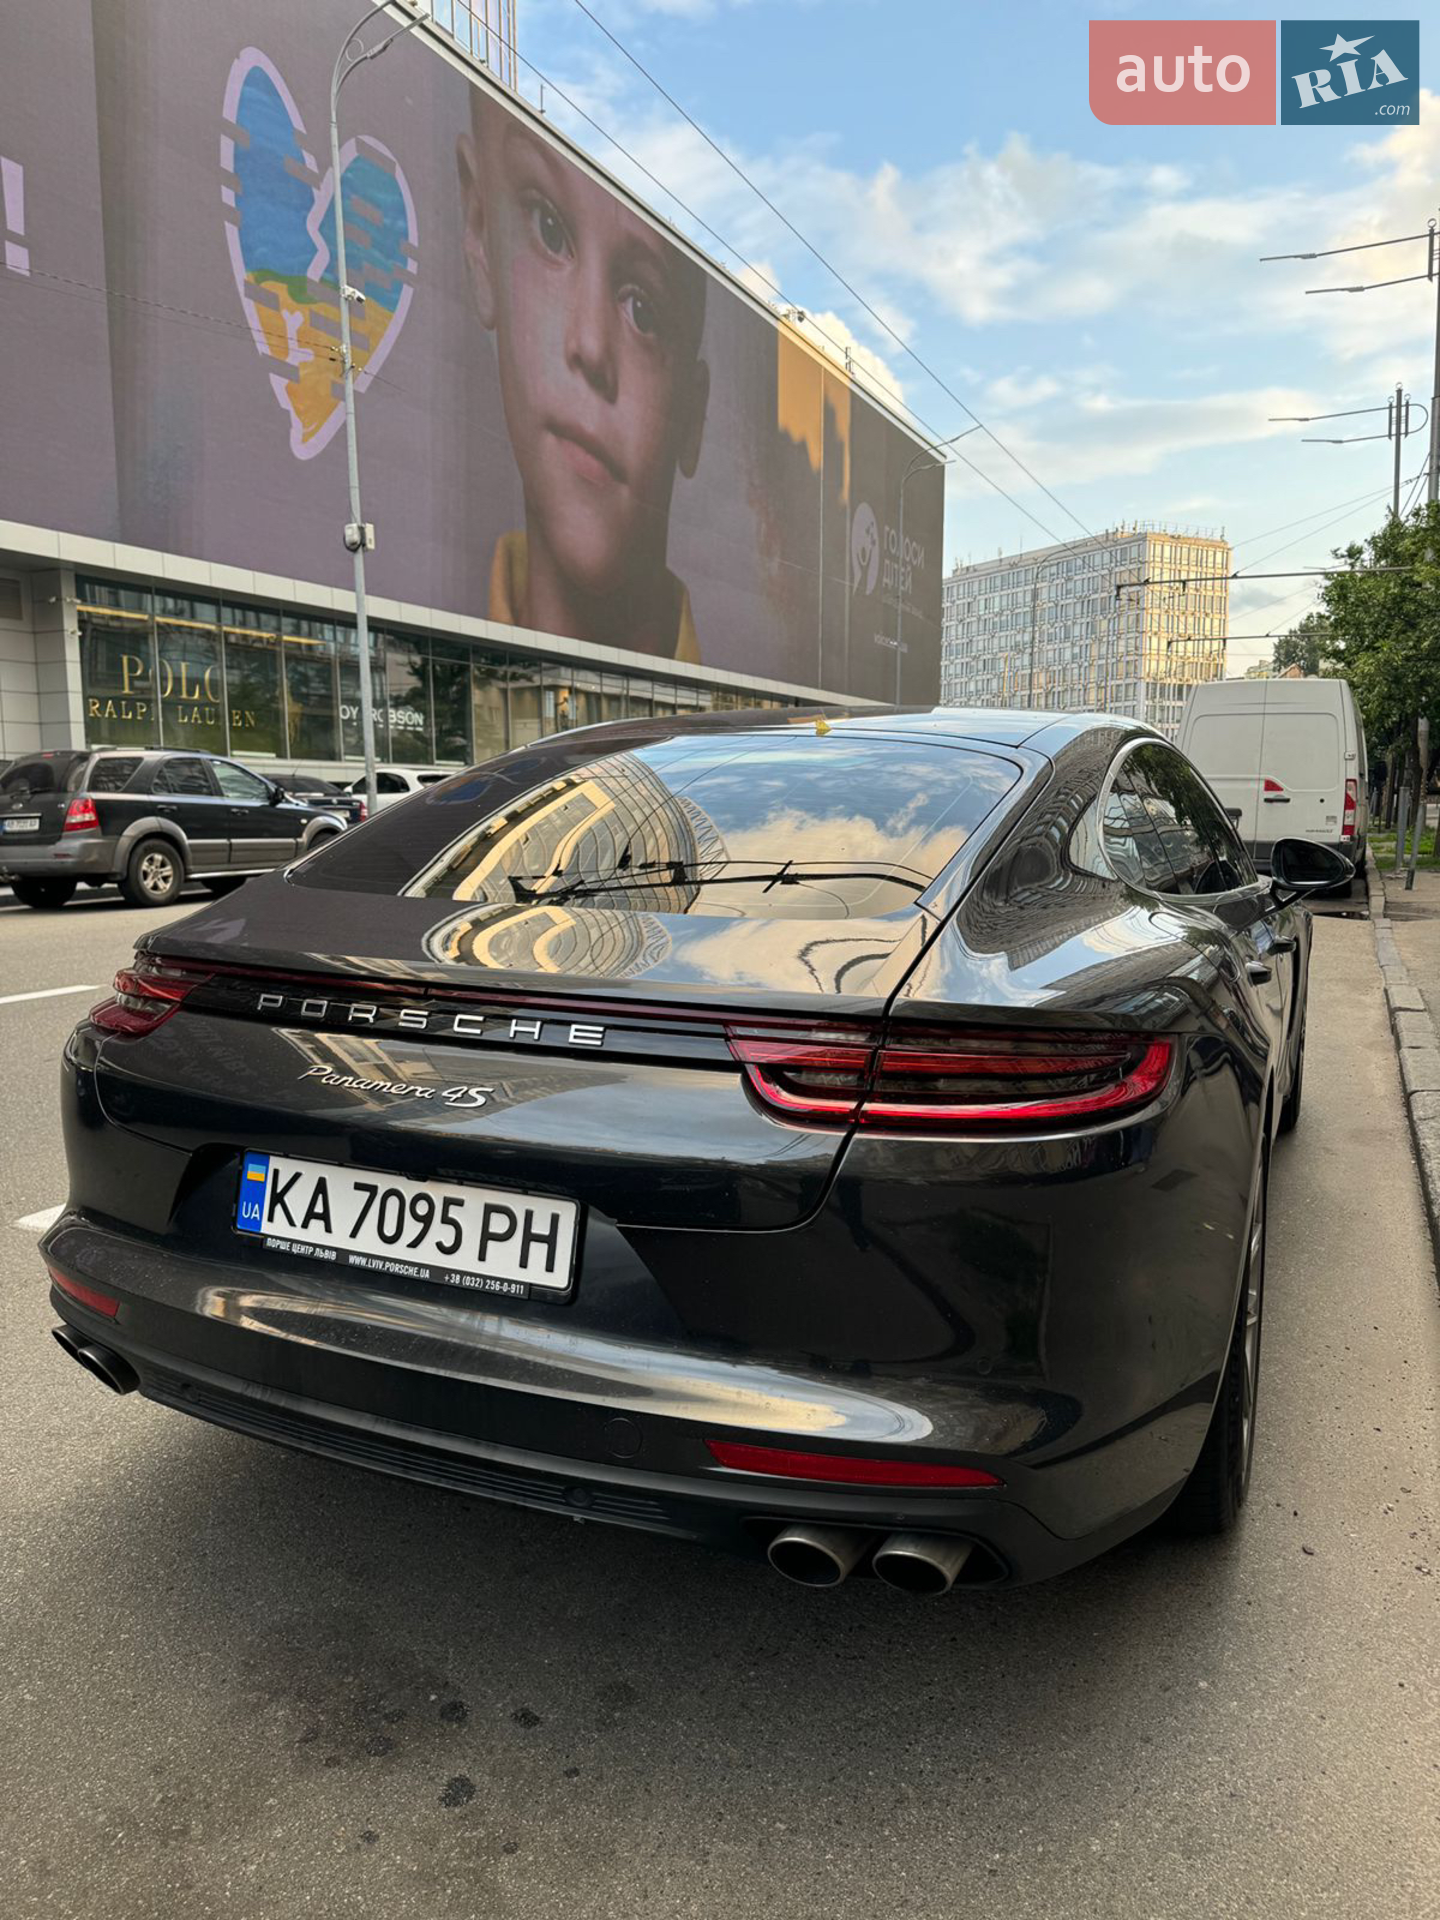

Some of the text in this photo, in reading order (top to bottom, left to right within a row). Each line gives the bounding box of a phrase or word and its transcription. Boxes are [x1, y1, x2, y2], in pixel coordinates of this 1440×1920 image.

[883, 525, 925, 570] ГООСИ
[88, 698, 255, 727] RALP LAUEN
[257, 994, 605, 1046] PORSCHE
[298, 1065, 495, 1108] Panamera 4S
[242, 1202, 260, 1221] UA
[267, 1168, 560, 1273] KA 7095 PH
[444, 1273, 525, 1295] +38 (032) 256-0-911
